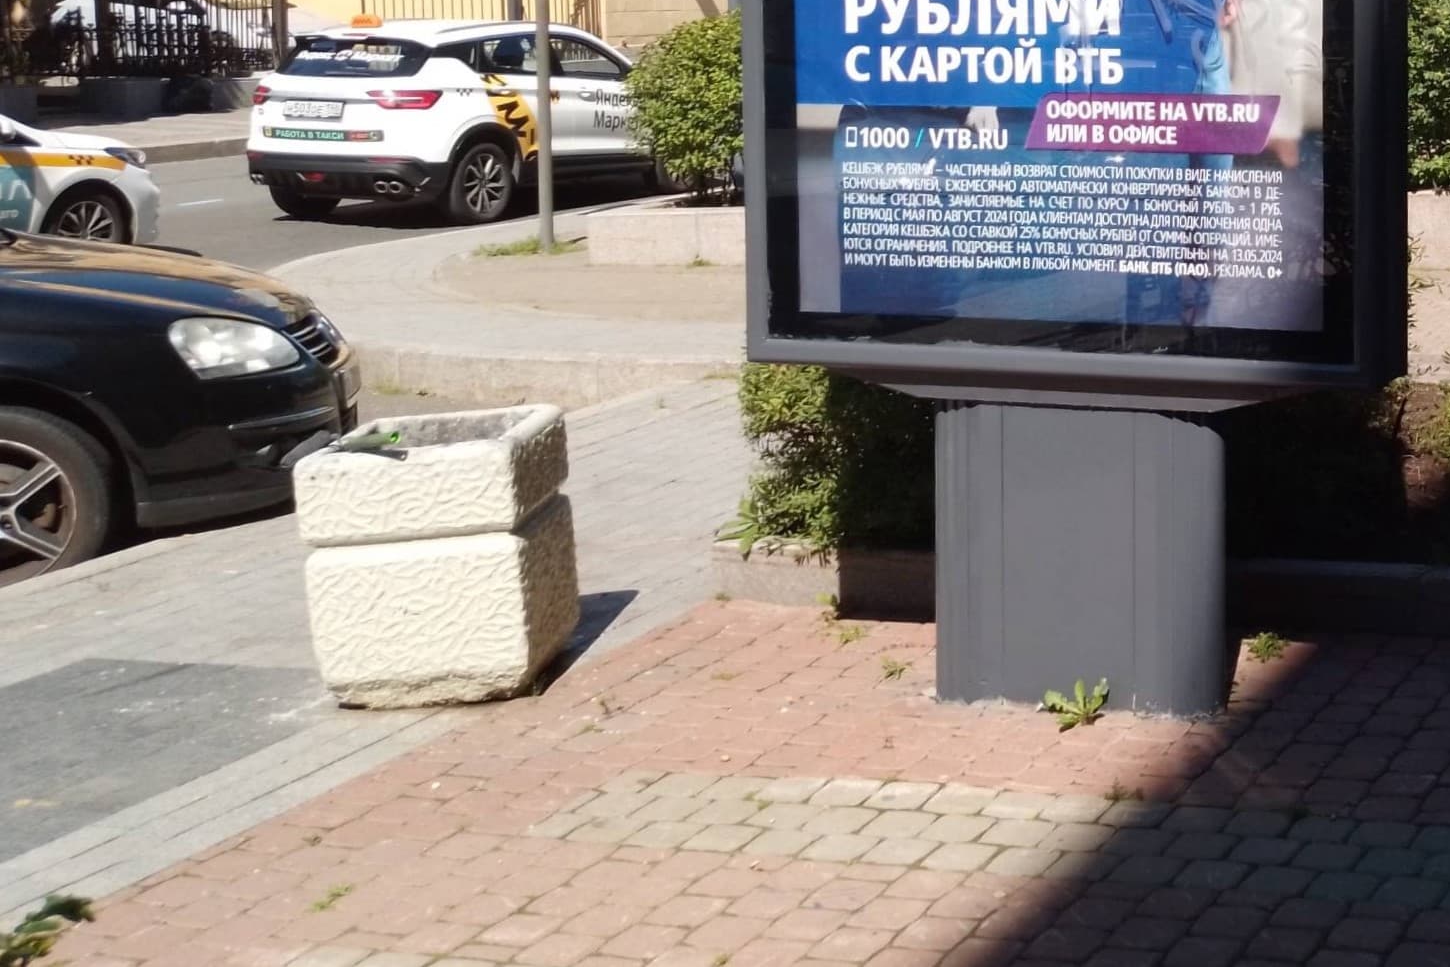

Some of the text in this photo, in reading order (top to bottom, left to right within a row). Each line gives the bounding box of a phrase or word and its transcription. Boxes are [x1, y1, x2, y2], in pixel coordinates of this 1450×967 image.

[844, 38, 1124, 85] С КАРТОЙ ВТБ
[596, 89, 640, 106] Янде
[1046, 100, 1260, 123] ОФОРМИТЕ НА VTB.RU
[859, 127, 909, 148] 1000
[928, 128, 1008, 150] VTB.RU
[1046, 124, 1177, 145] ИЛИ В ОФИСЕ
[842, 162, 883, 174] КЕШБЭК
[886, 162, 934, 175] РУБЛЯМИ
[945, 161, 1011, 176] ЧАСТИЧНЫЙ
[1014, 164, 1057, 177] ВОЗВРАТ
[1060, 165, 1122, 179] СТОИМОСТИ
[1125, 166, 1173, 180] ПОКУПКИ
[1176, 168, 1182, 181] В
[1185, 168, 1211, 183] ВИДЕ
[1214, 169, 1283, 183] НАЧИСЛЕНИЯ
[843, 177, 898, 190] БОНУСНЫХ
[945, 179, 1016, 192] ЕЖЕМЕСЯЧНО
[1020, 180, 1107, 194] АВТОМАТИЧЕСКИ
[1111, 182, 1202, 196] КОНВЕРТИРУЕМЫХ
[1206, 185, 1249, 198] БАНКОМ
[1254, 187, 1261, 199] В
[1265, 187, 1283, 201] ДЕ-
[843, 193, 886, 205] НЕЖНЫЕ
[948, 194, 1024, 208] ЗАЧИСЛЯЕМЫЕ
[1029, 196, 1045, 208] НА
[1049, 196, 1073, 208] СЧЕТ
[1078, 196, 1093, 209] ПО
[1097, 198, 1129, 210] КУРСУ
[1134, 199, 1139, 211] 1
[1144, 197, 1198, 212] БОНУСНЫЙ
[1203, 201, 1235, 214] РУБЛЬ
[1250, 203, 1255, 215] 1
[1261, 203, 1283, 215] РУБ.
[844, 207, 1283, 232] В ПЕРИОД С МАЯ ПО АВГУСТ 2024 ГОДА КЛИЕНТАМ ДОСТУПНА ДЛЯ ПОДКЛЮЧЕНИЯ ОДНА
[843, 223, 899, 236] КАТЕГОРИЯ
[901, 224, 950, 237] КЕШБЭКА
[952, 225, 966, 238] СО
[969, 223, 1018, 238] СТАВКОЙ
[1019, 226, 1040, 239] 25%
[1042, 227, 1098, 240] БОНУСНЫХ
[1100, 227, 1136, 242] РУБЛЕЙ
[1139, 230, 1152, 242] ОТ
[1154, 231, 1192, 244] СУММЫ
[1255, 234, 1283, 248] ИМЕ-
[844, 238, 872, 249] ЮТСЯ
[874, 238, 948, 252] ОГРАНИЧЕНИЯ.
[952, 241, 1014, 254] ПОДРОБНЕЕ
[1016, 241, 1032, 254] НА
[1077, 244, 1123, 256] УСЛОВИЯ
[1125, 243, 1210, 260] ДЕЙСТВИТЕЛЬНЫ
[1214, 248, 1228, 261] НА
[1233, 249, 1283, 263] 13.05.2024
[845, 253, 1283, 278] И МОГУТ БЫТЬ ИЗМЕНЕНЫ БАНКОМ В ЛЮБОЙ МОМЕНТ. БАНК ВТБ (ПАО). РЕКЛАМА. 0+
